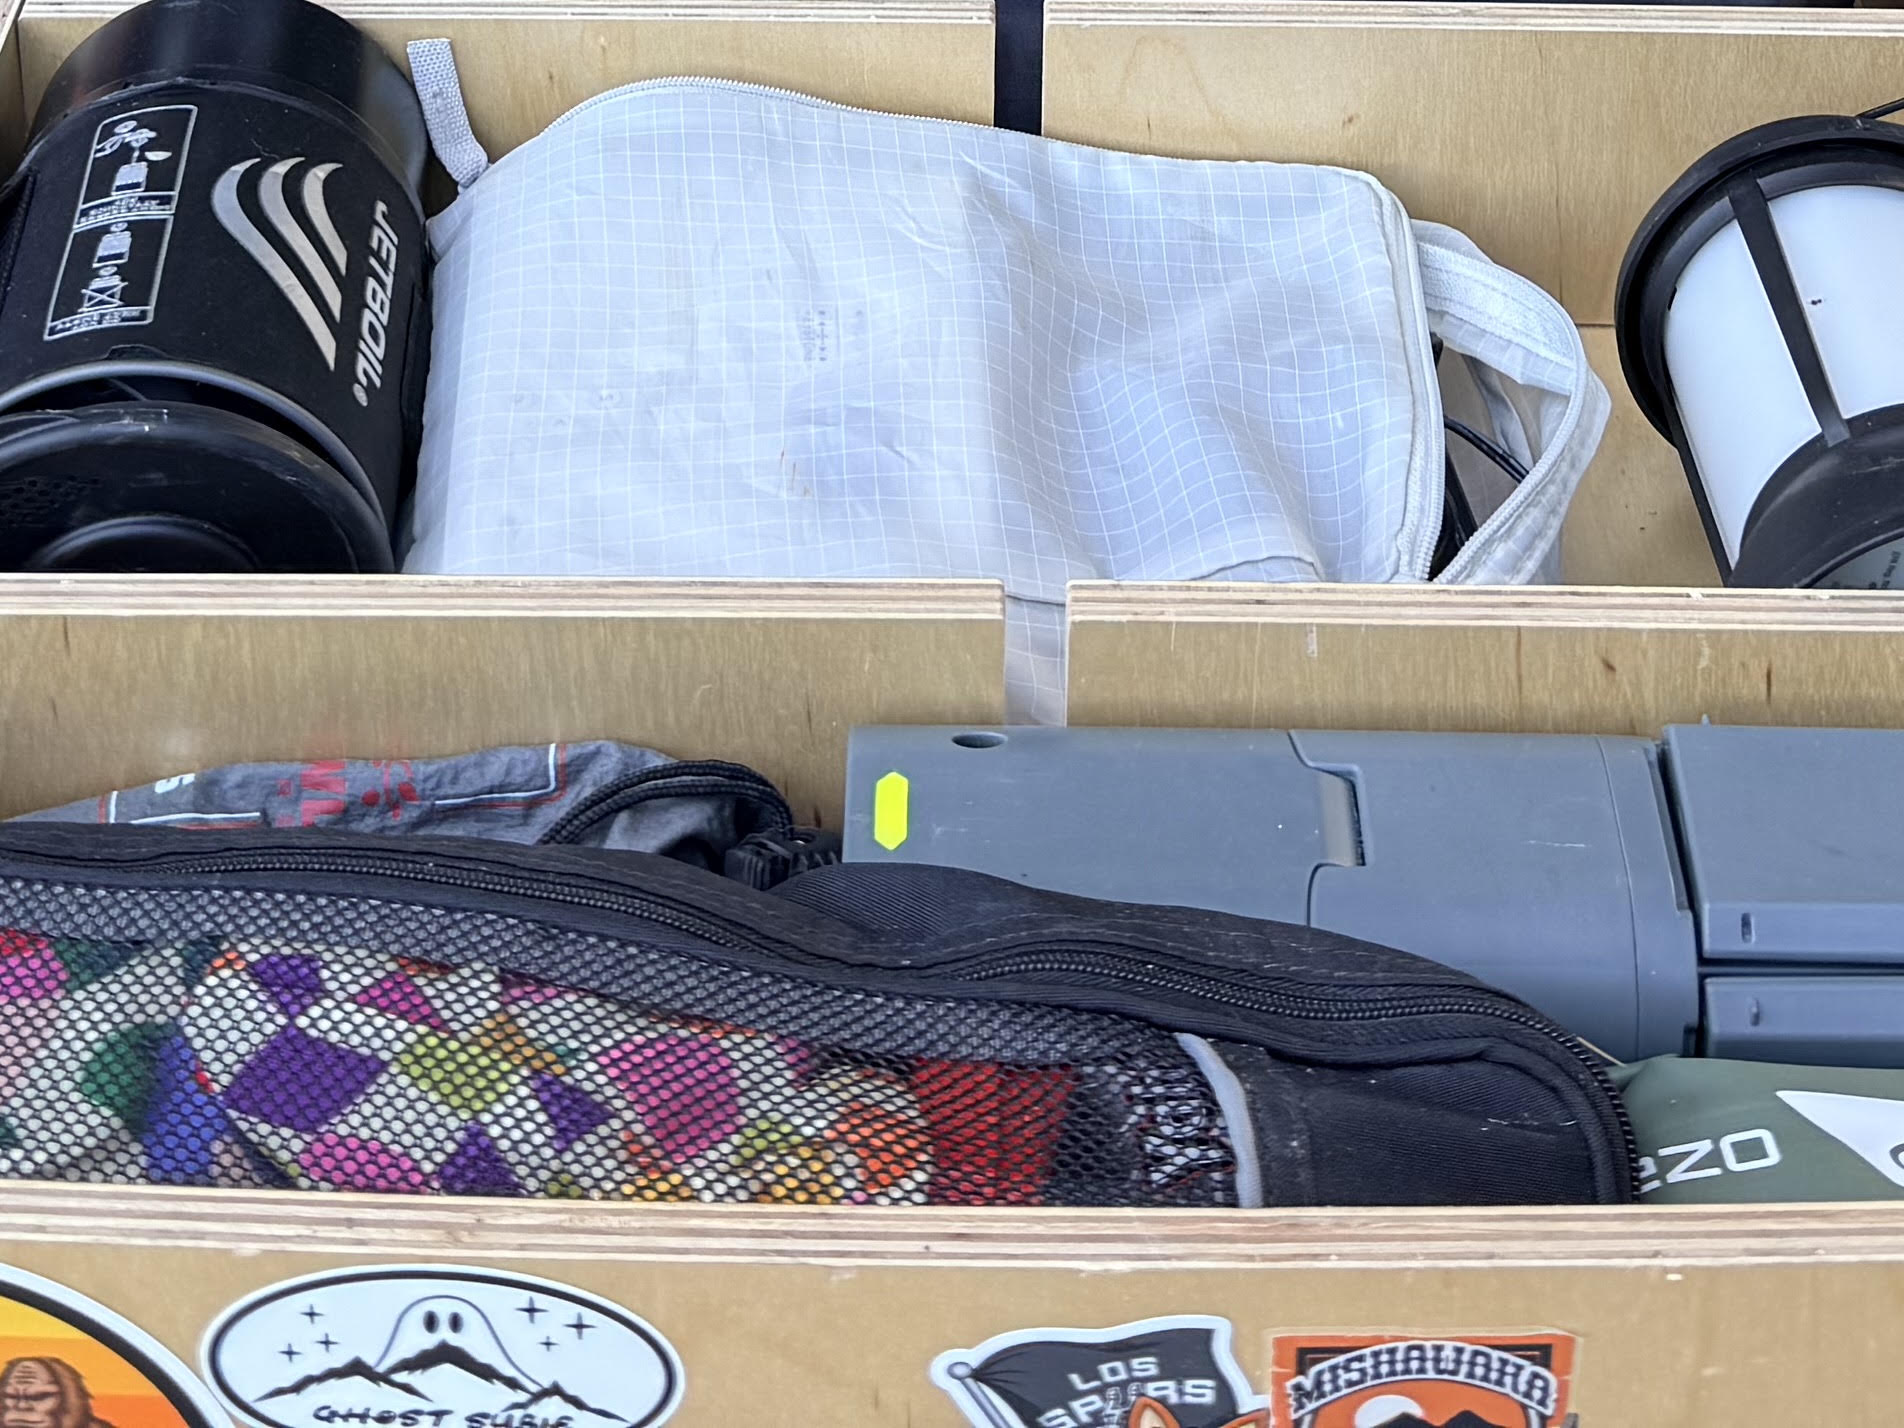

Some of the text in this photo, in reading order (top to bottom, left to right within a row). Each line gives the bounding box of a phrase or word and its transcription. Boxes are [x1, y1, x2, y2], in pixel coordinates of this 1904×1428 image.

[356, 200, 399, 390] JETBOIL
[1067, 1354, 1160, 1392] LOS
[1287, 1343, 1559, 1419] MISHAWAKA
[312, 1404, 455, 1427] GHOST
